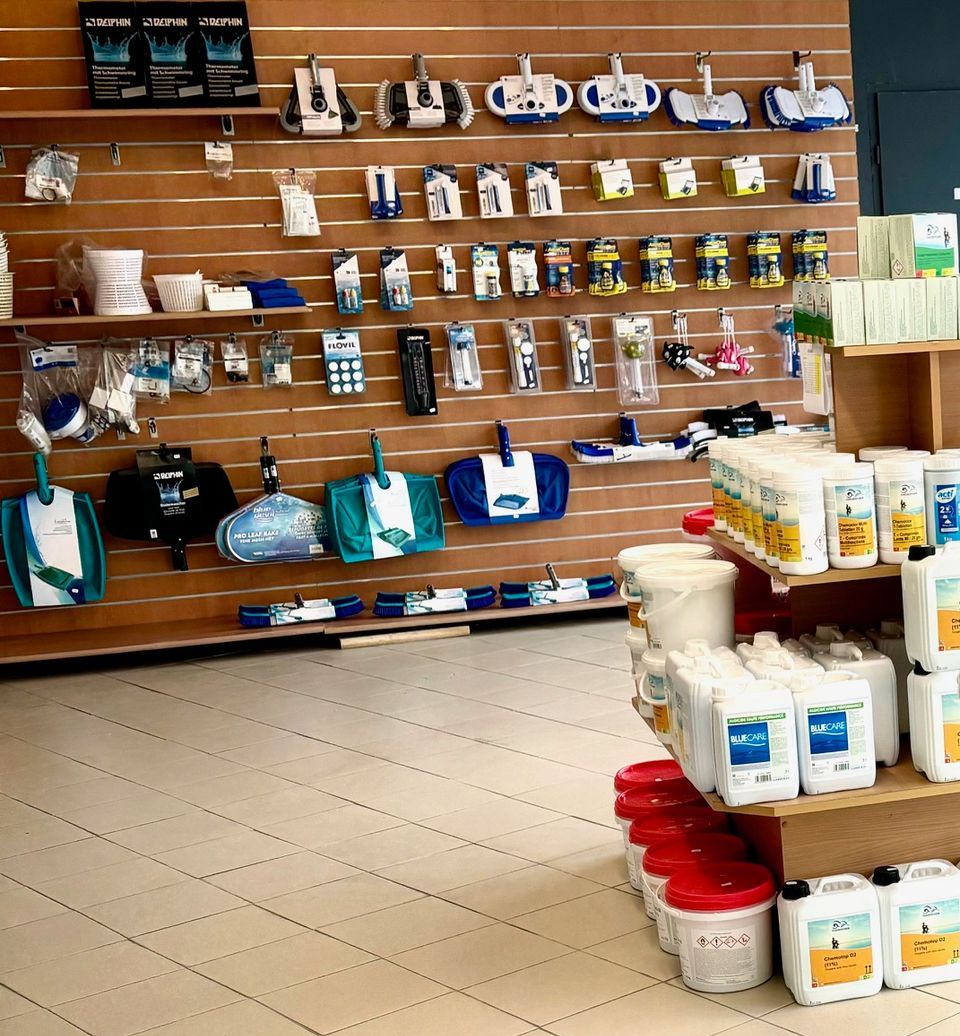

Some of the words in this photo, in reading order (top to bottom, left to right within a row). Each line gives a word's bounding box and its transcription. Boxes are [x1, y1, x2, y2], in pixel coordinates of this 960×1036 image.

[97, 18, 131, 27] DELPHIN
[154, 18, 188, 26] DELPHIN
[209, 17, 243, 26] DELPHIN
[810, 722, 845, 733] BLUECARE
[730, 732, 767, 743] BLUECARE
[824, 954, 849, 962] Chemotop
